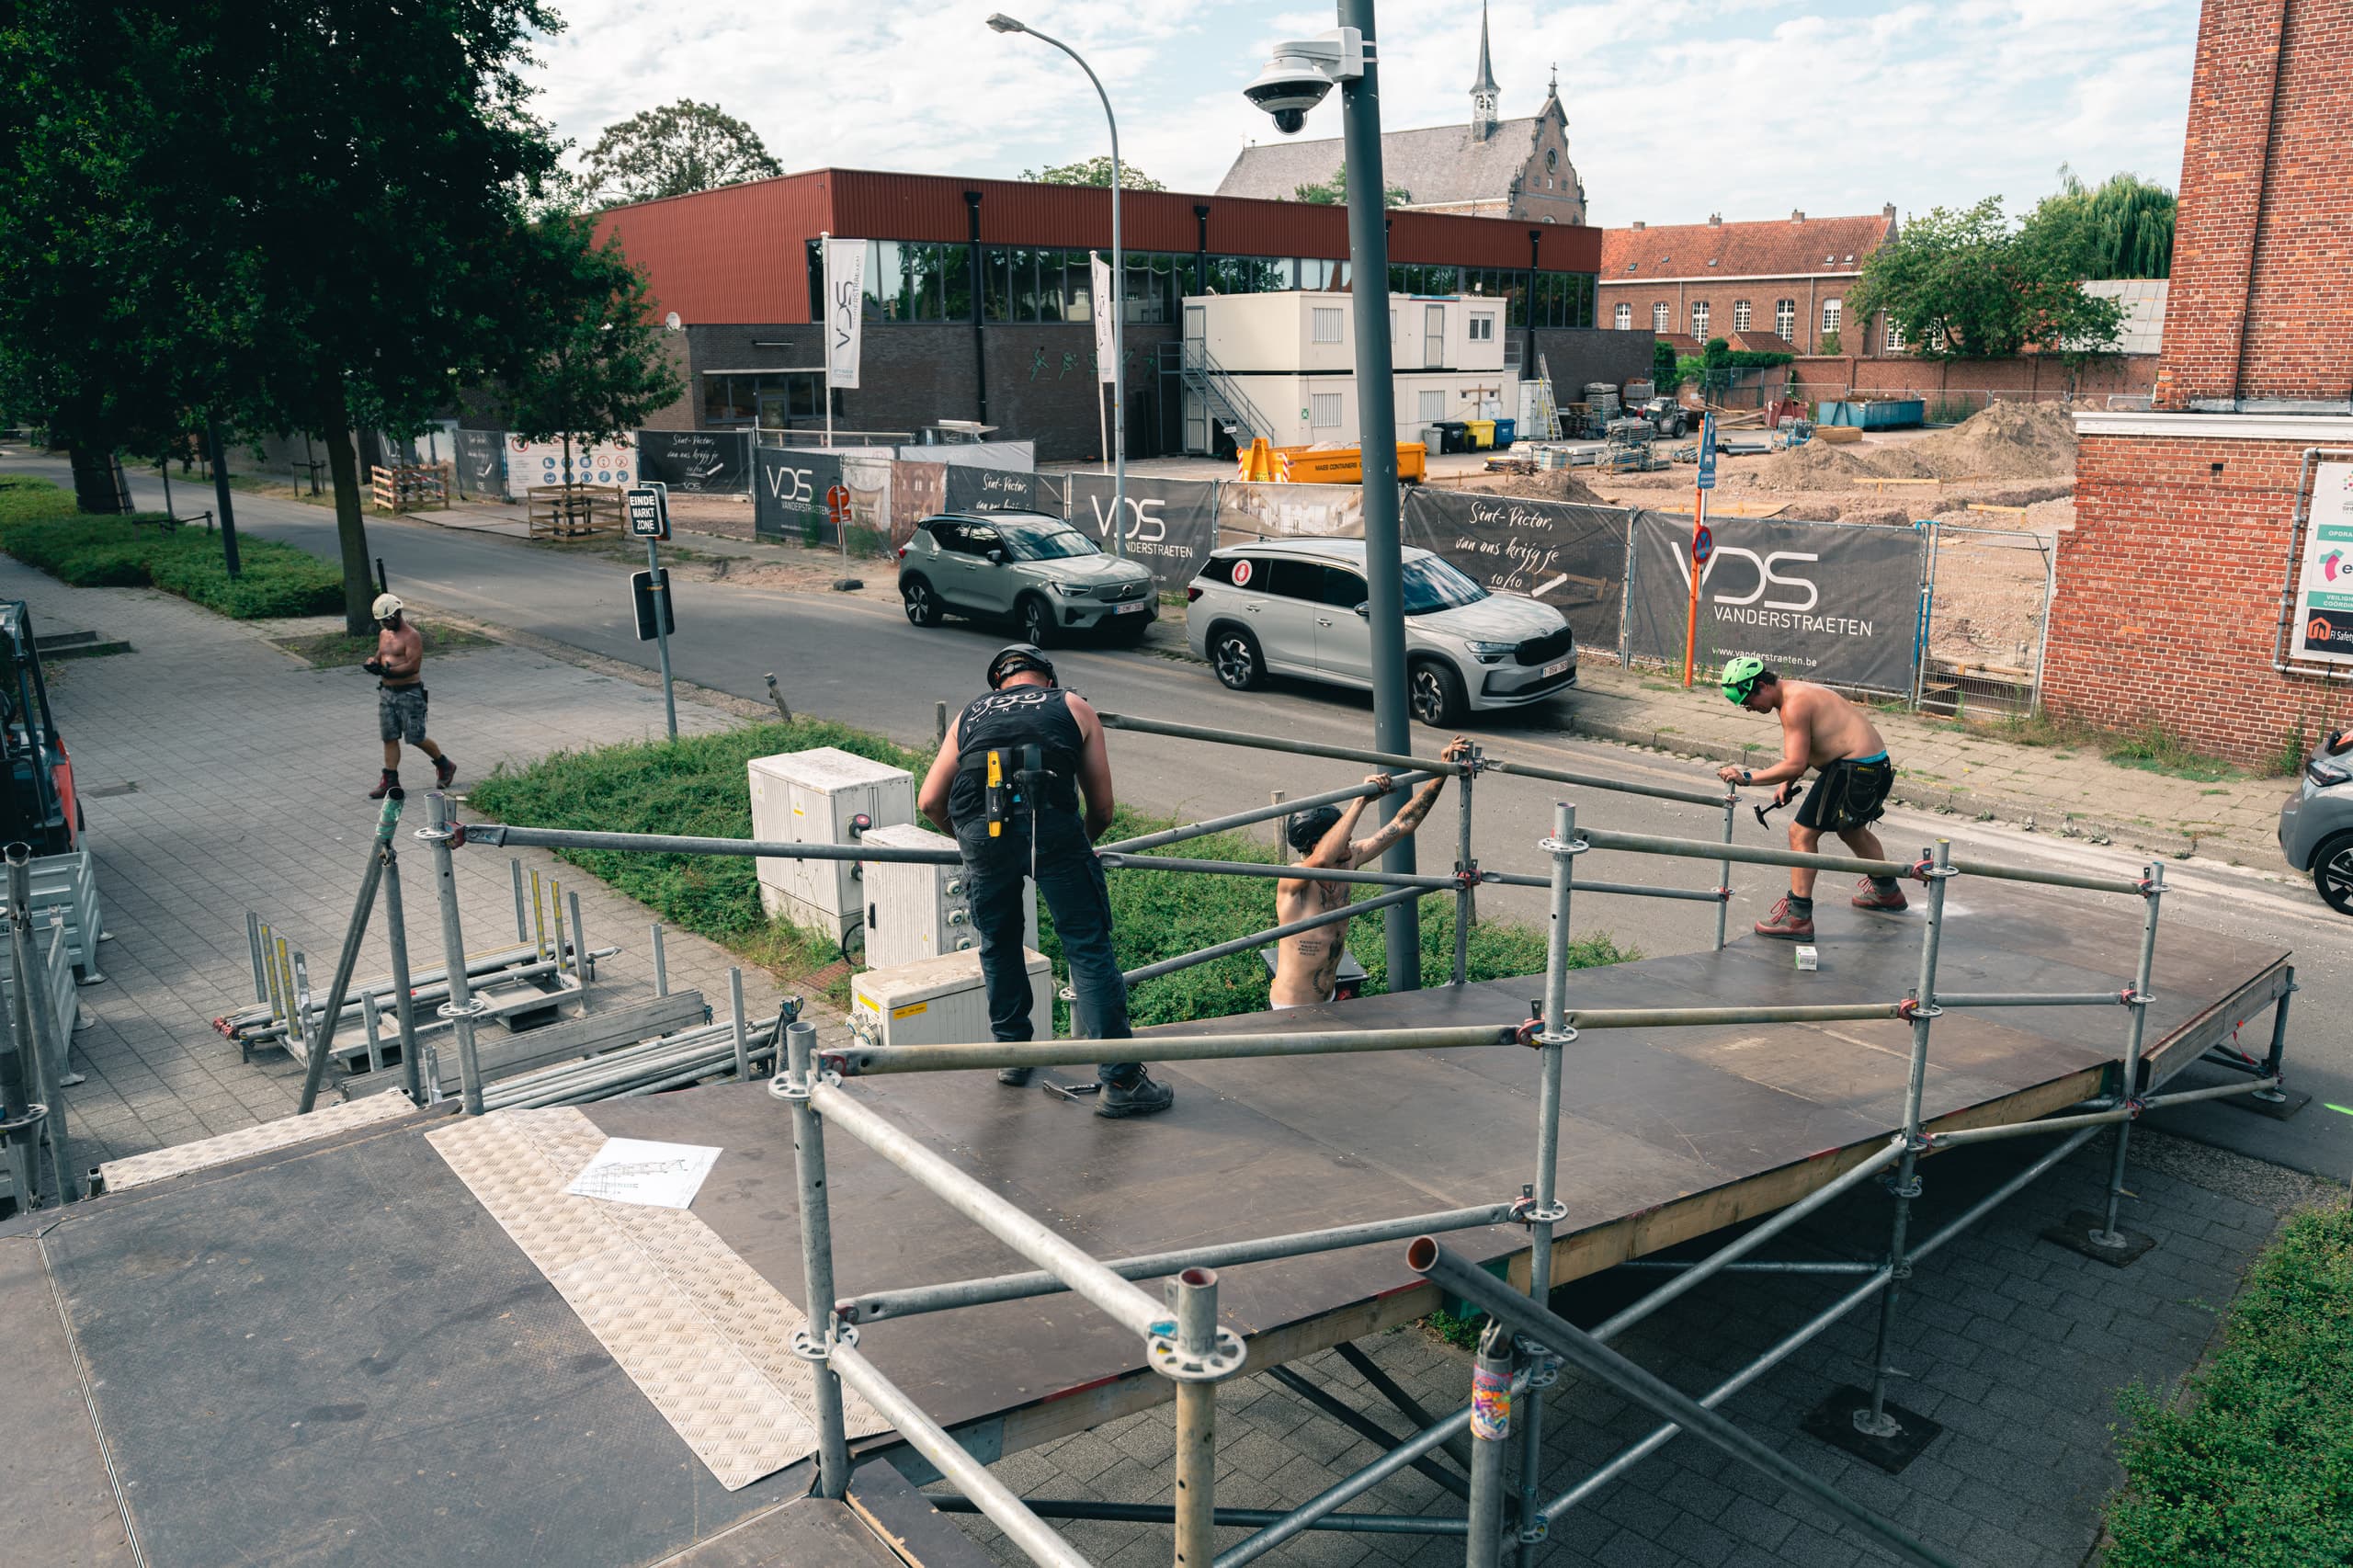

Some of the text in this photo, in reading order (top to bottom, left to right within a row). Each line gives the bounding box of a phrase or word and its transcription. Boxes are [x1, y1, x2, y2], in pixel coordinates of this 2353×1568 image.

[766, 465, 813, 503] VDS
[630, 495, 655, 506] EINDE
[632, 507, 654, 517] MARKT
[636, 520, 655, 530] ZONE
[1090, 494, 1166, 542] VDS
[1469, 501, 1553, 531] Sint-Victor,
[1455, 536, 1560, 575] van ons krijg je
[1490, 572, 1523, 589] 10/10
[1670, 540, 1819, 611] VDS
[1713, 605, 1873, 637] VANDERSTRAETEN
[1711, 646, 1818, 667] www.vanderstraeten.be
